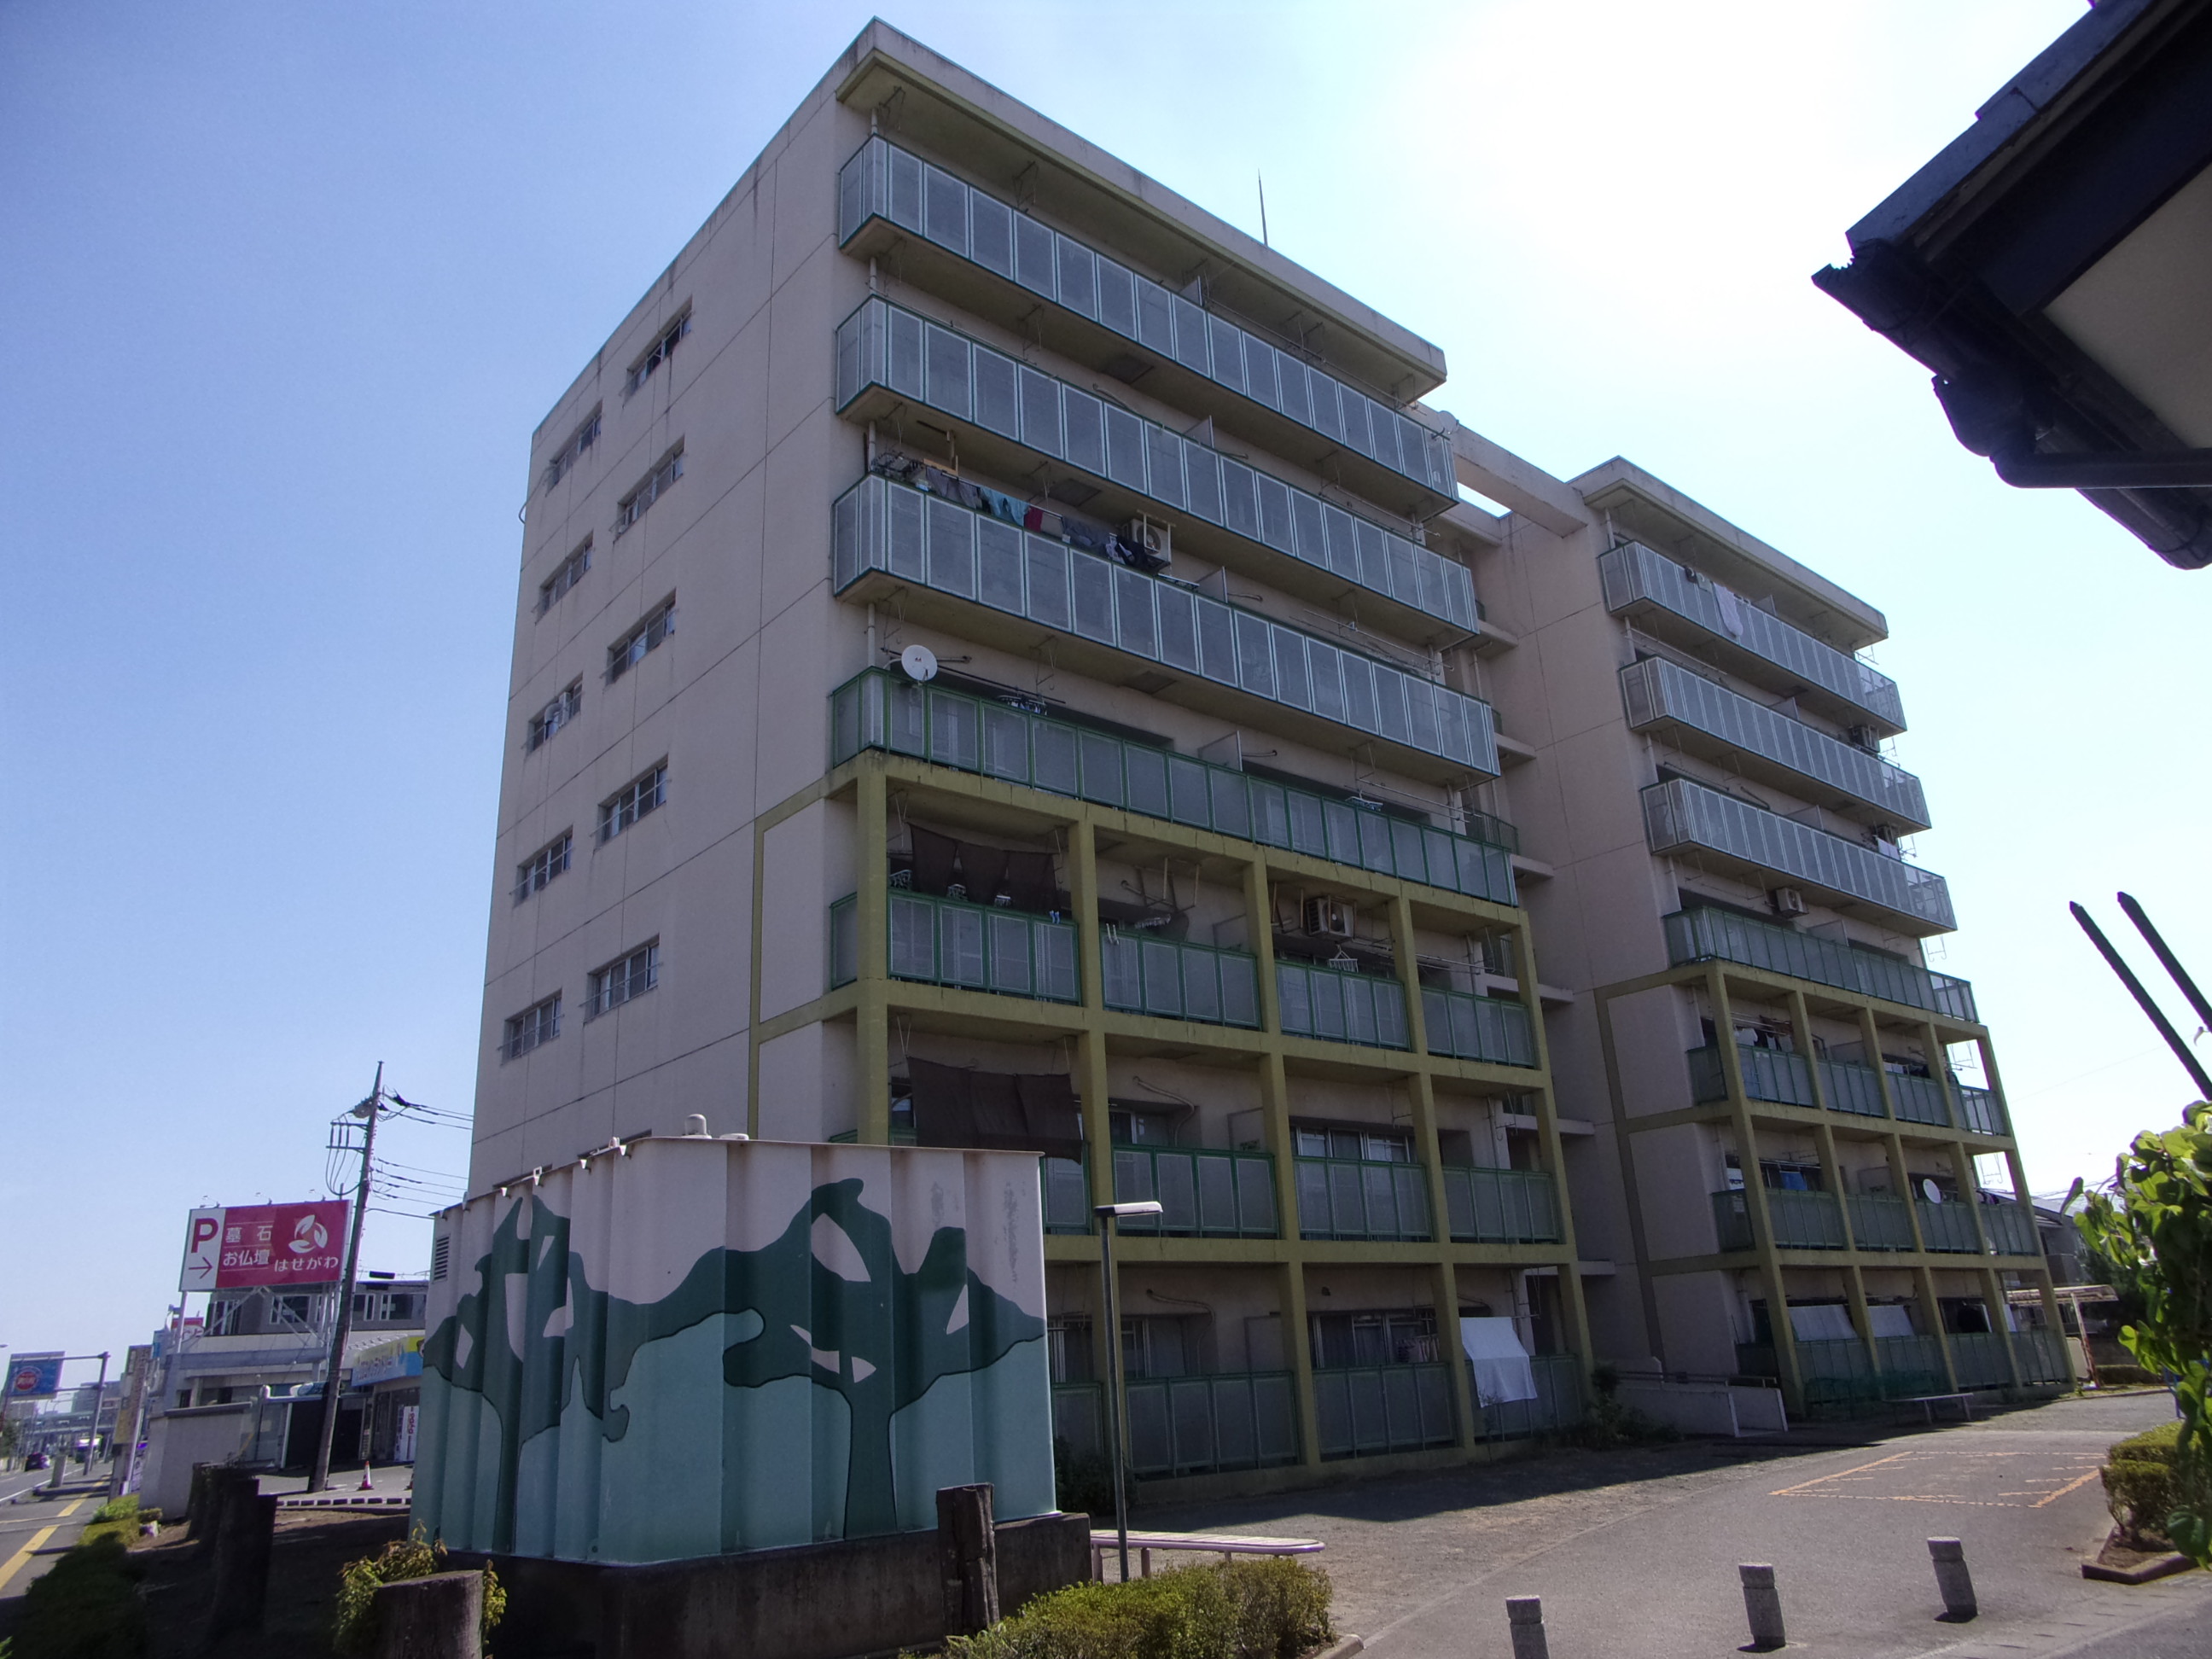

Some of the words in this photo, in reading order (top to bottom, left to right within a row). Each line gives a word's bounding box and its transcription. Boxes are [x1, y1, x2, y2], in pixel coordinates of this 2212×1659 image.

[191, 1218, 219, 1253] P
[223, 1249, 270, 1266] お仏壇
[274, 1256, 339, 1272] はせがわ
